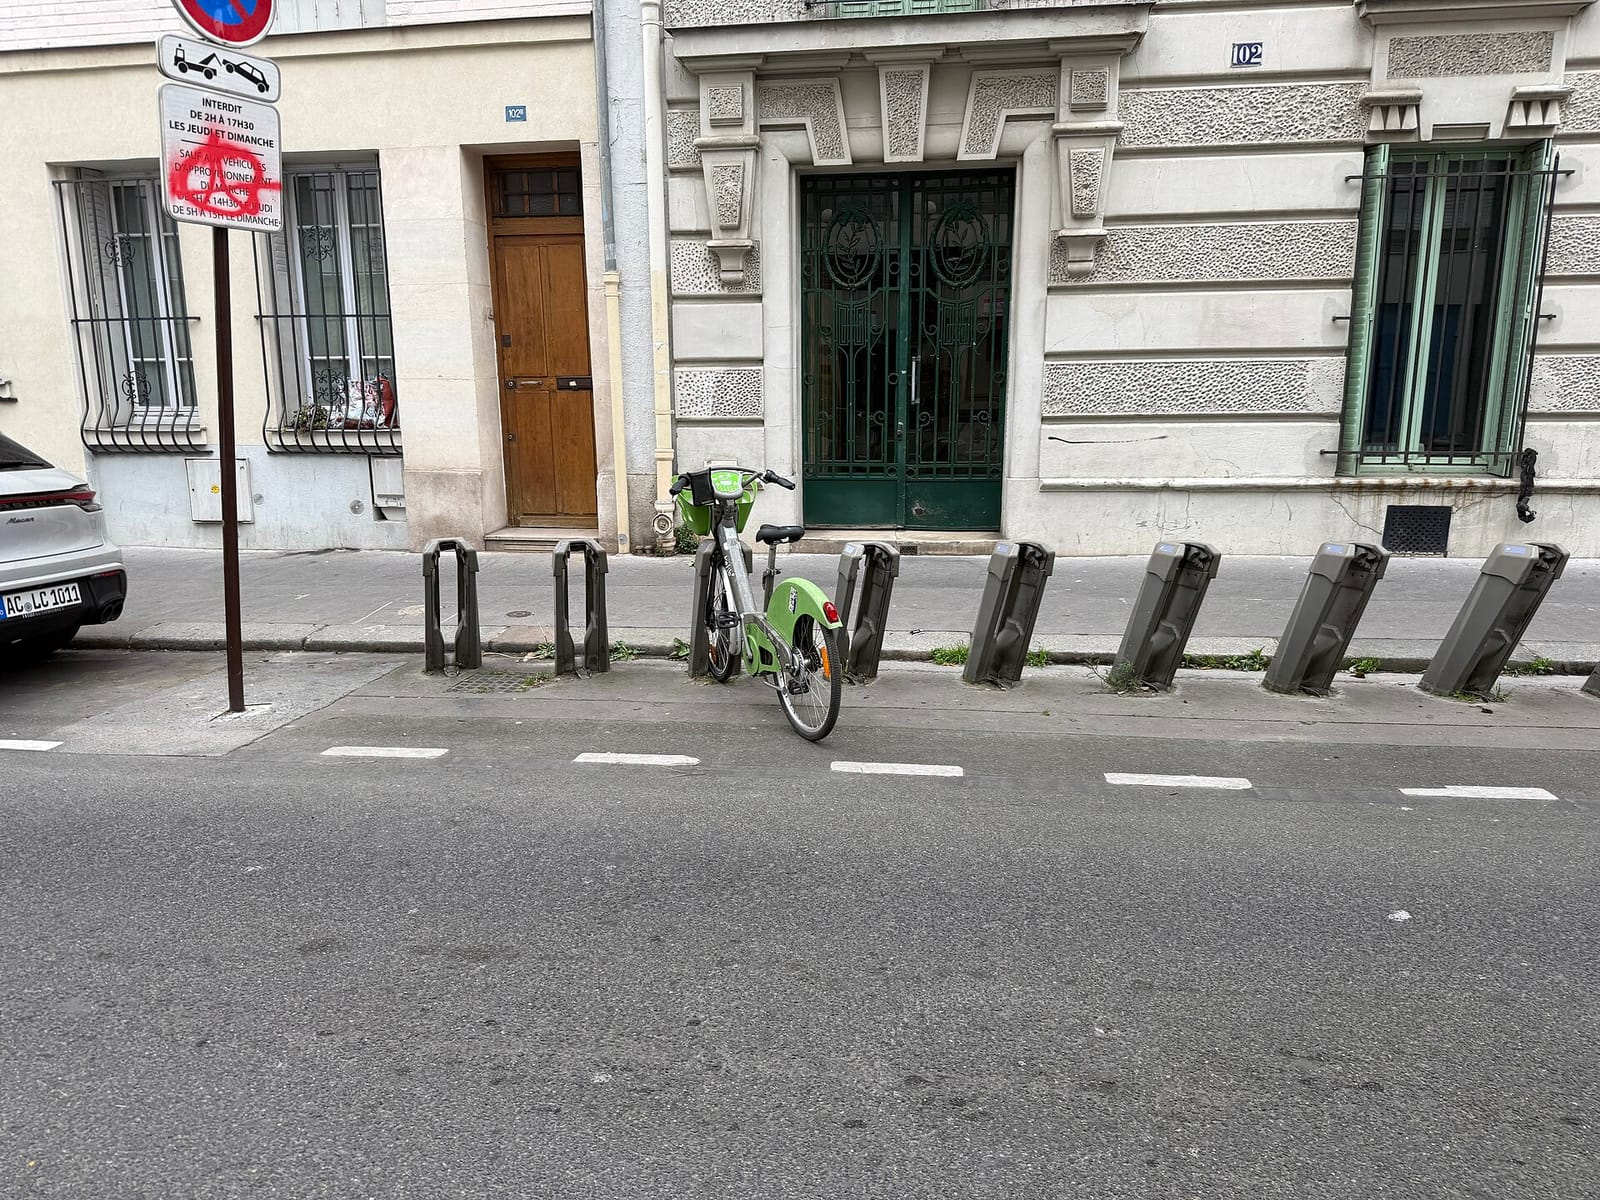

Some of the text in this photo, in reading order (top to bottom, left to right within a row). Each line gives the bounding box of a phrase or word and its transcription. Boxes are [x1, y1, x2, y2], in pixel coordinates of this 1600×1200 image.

[1232, 44, 1262, 65] 102
[202, 97, 243, 114] INTERDIT
[190, 109, 203, 121] DE
[204, 112, 217, 123] 2H
[227, 117, 255, 131] 17H30
[169, 119, 275, 149] LES JEUDI ET DIMANCHE
[204, 152, 221, 164] AU
[213, 196, 238, 209] 14H30
[250, 201, 273, 213] JUDI
[172, 204, 184, 214] DE
[186, 206, 198, 217] 5H
[236, 214, 279, 228] DIMANCHE
[7, 595, 24, 615] AC
[31, 591, 49, 609] LC
[50, 585, 80, 606] 1011
